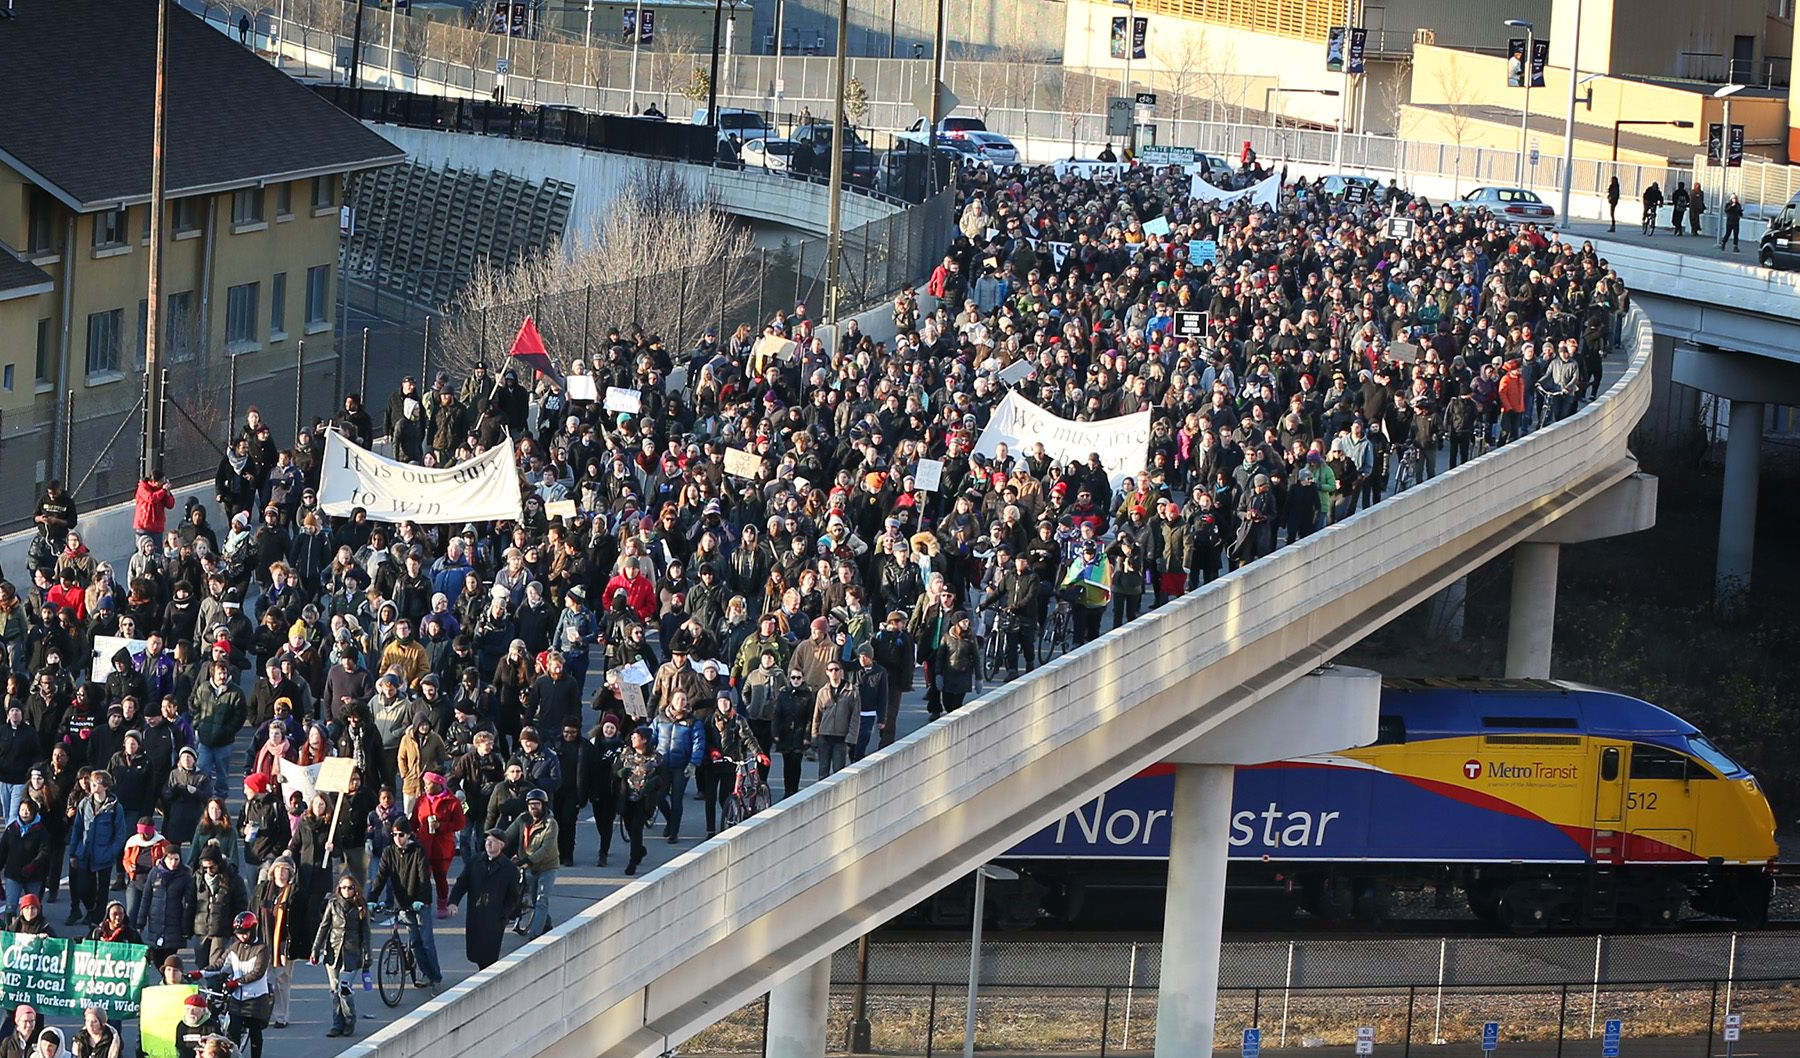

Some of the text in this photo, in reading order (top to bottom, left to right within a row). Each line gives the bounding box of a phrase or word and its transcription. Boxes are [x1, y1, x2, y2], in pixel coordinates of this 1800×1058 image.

[1012, 405, 1044, 434] We
[1053, 427, 1100, 447] must
[342, 447, 362, 472] It
[374, 463, 392, 479] is
[402, 470, 439, 483] our
[350, 487, 376, 507] to
[1626, 792, 1657, 810] 512
[3, 944, 67, 975] Clerical
[73, 950, 146, 985] Workers
[26, 976, 66, 992] Local
[8, 991, 31, 1003] with
[36, 993, 76, 1009] Workers
[114, 1000, 140, 1013] Wide
